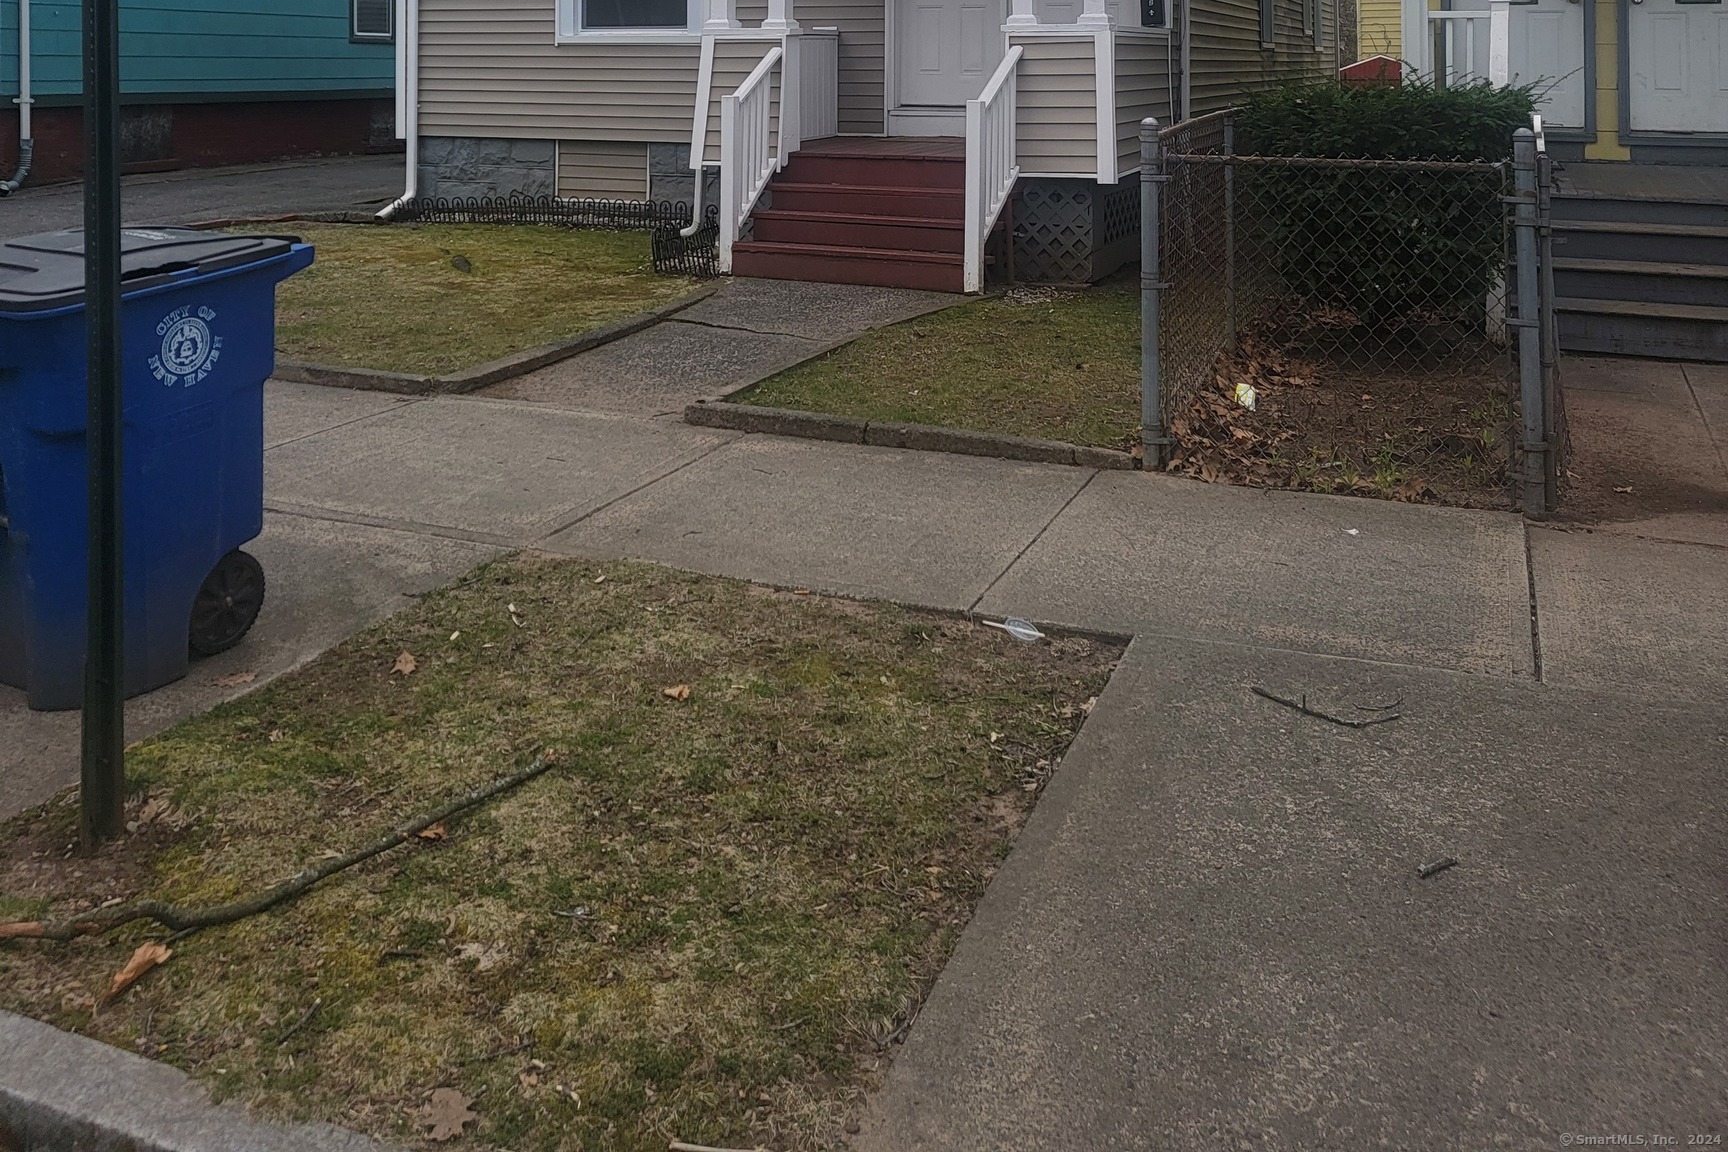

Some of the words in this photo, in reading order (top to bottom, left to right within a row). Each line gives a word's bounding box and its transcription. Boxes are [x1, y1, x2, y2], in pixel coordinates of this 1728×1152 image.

[156, 305, 191, 336] CITY
[197, 306, 217, 322] OF
[148, 354, 178, 387] NEW
[184, 336, 223, 388] HAVEN
